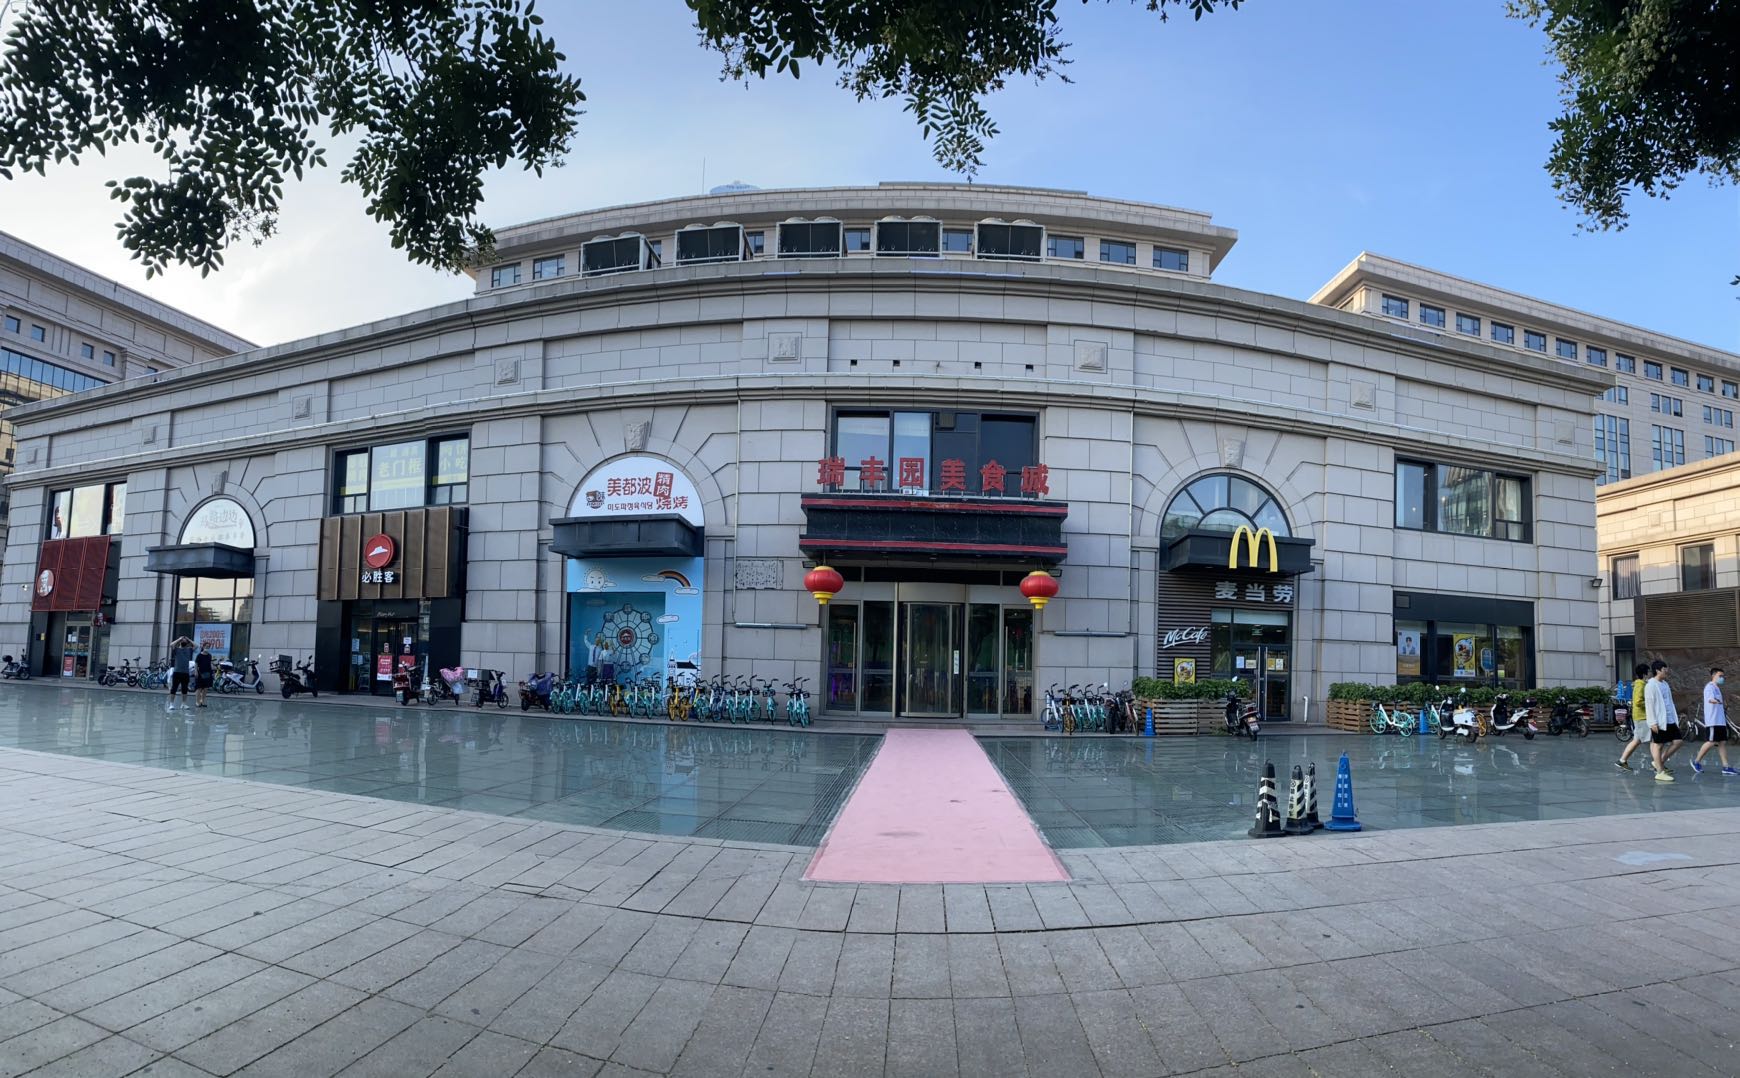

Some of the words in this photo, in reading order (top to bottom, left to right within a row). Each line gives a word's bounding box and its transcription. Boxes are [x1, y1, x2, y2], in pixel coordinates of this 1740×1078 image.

[379, 456, 423, 477] 老门框
[816, 455, 1050, 495] 瑞丰园美食城
[607, 476, 652, 497] 美都波
[656, 495, 689, 511] 烧烤
[361, 570, 394, 584] 必胜客
[1215, 580, 1295, 604] 麦当劳
